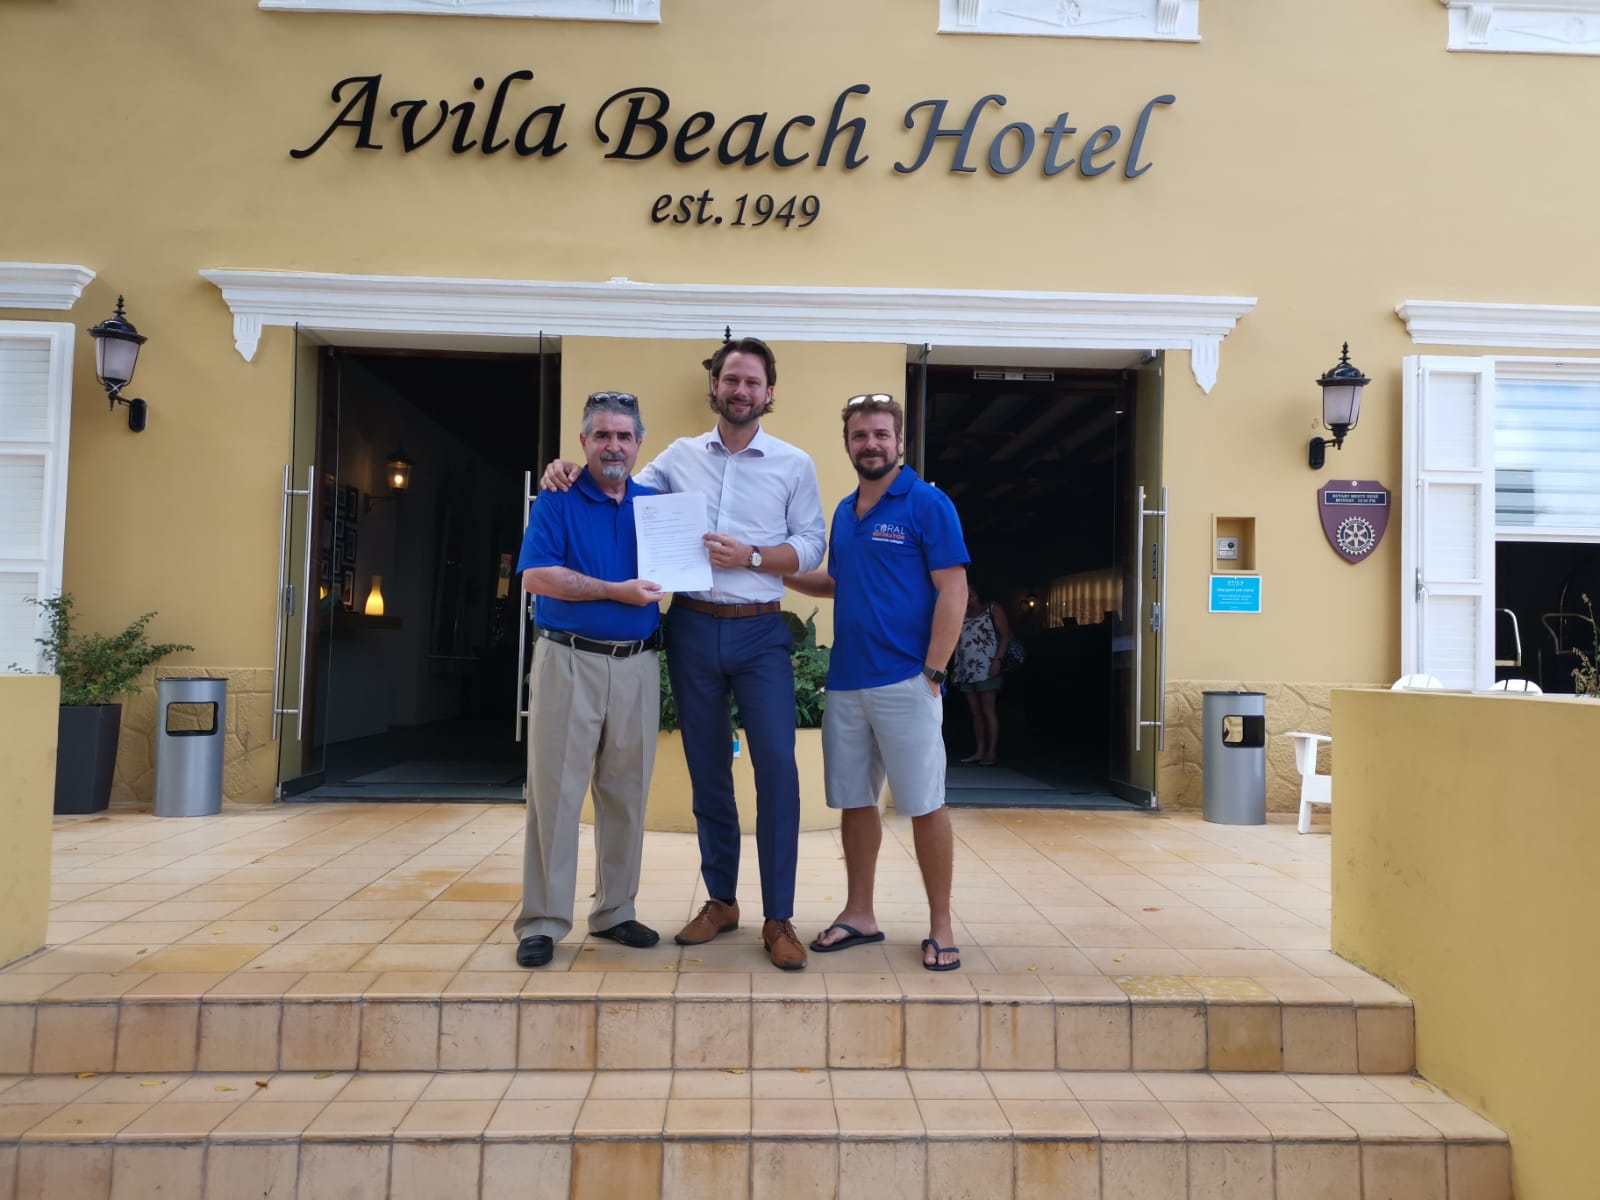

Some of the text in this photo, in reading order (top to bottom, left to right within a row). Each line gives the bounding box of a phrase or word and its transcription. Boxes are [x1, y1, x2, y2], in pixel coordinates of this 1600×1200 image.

[289, 70, 1176, 181] Avila Beach Hotel
[873, 523, 904, 535] CORAL
